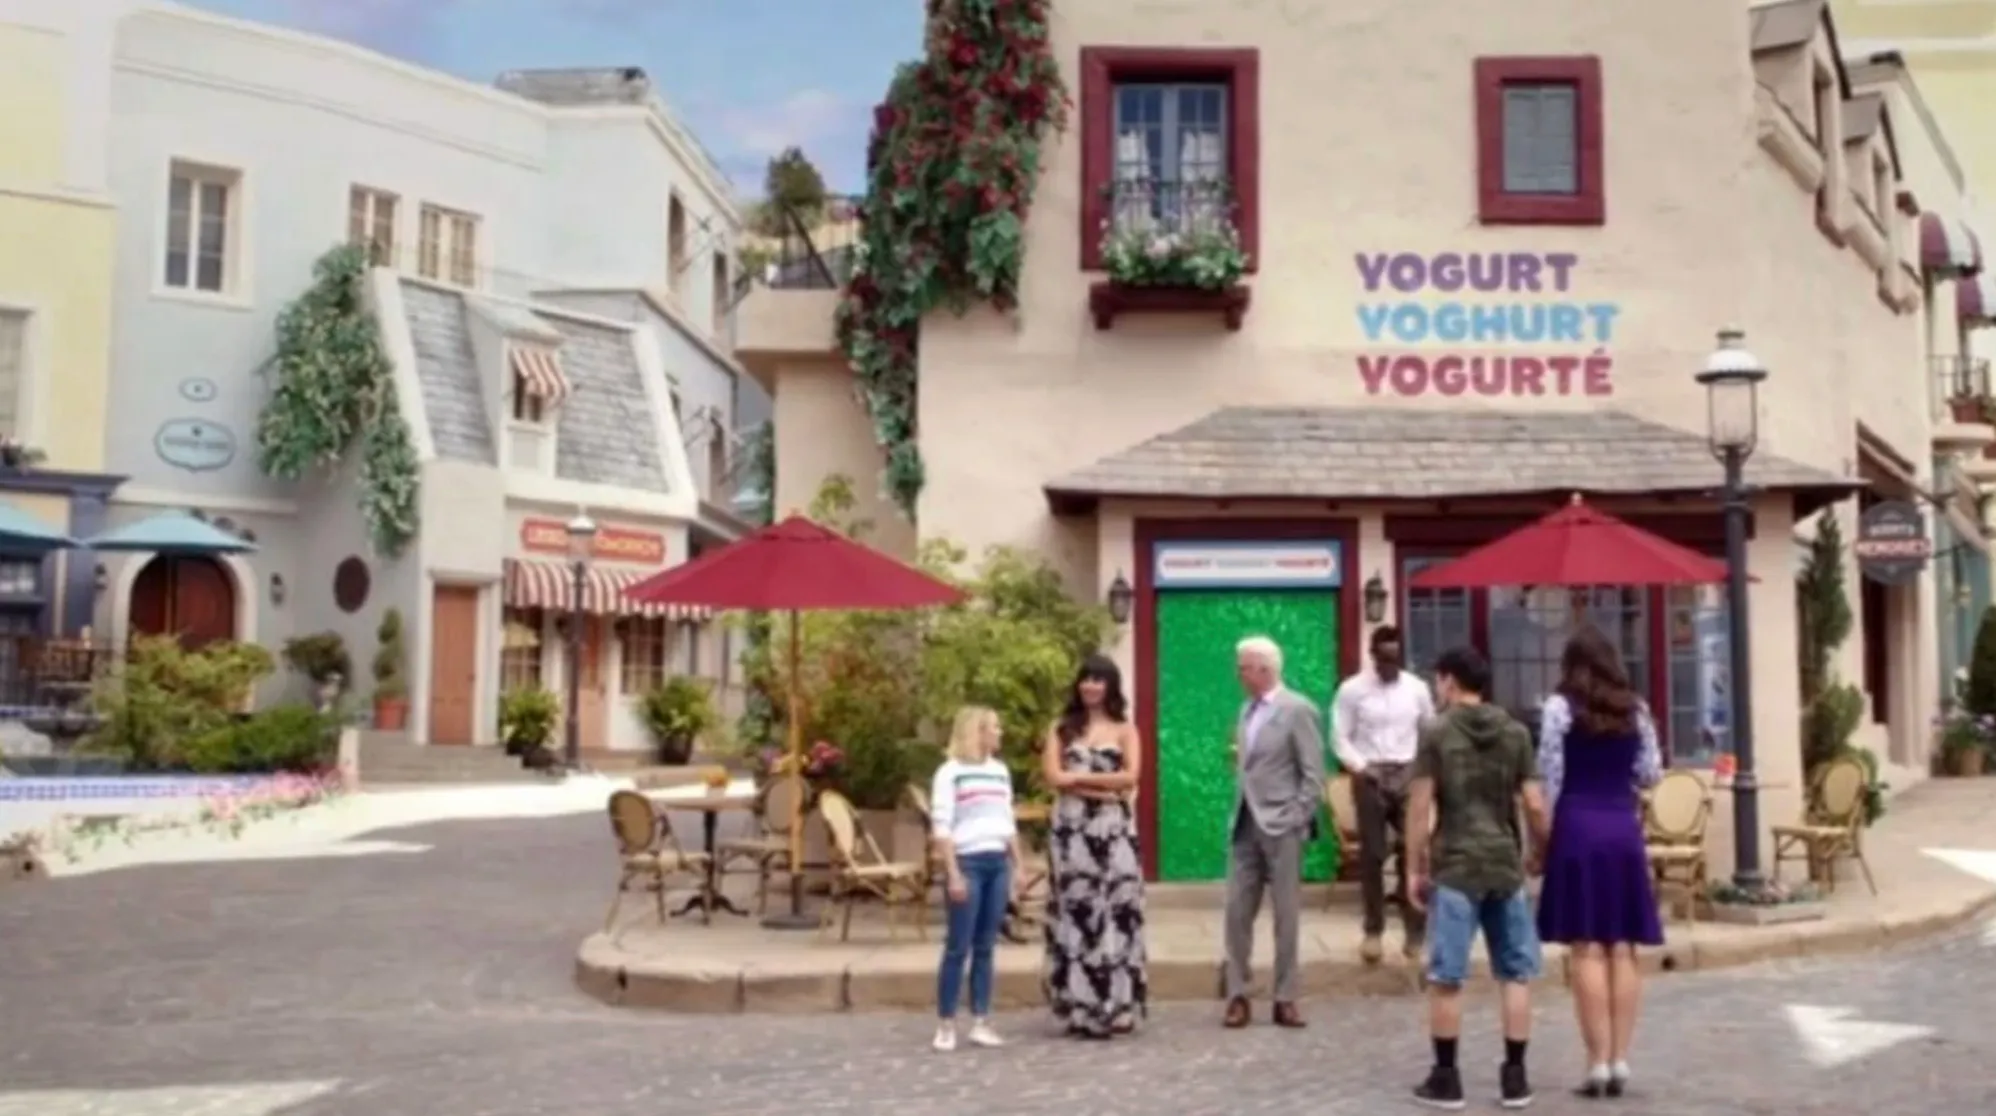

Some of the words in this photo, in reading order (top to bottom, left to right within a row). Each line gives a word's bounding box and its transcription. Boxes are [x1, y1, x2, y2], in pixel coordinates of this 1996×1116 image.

[1355, 253, 1578, 291] YOGURT
[1356, 303, 1618, 342] YOGHURT
[1356, 347, 1614, 395] YOGURTÉ
